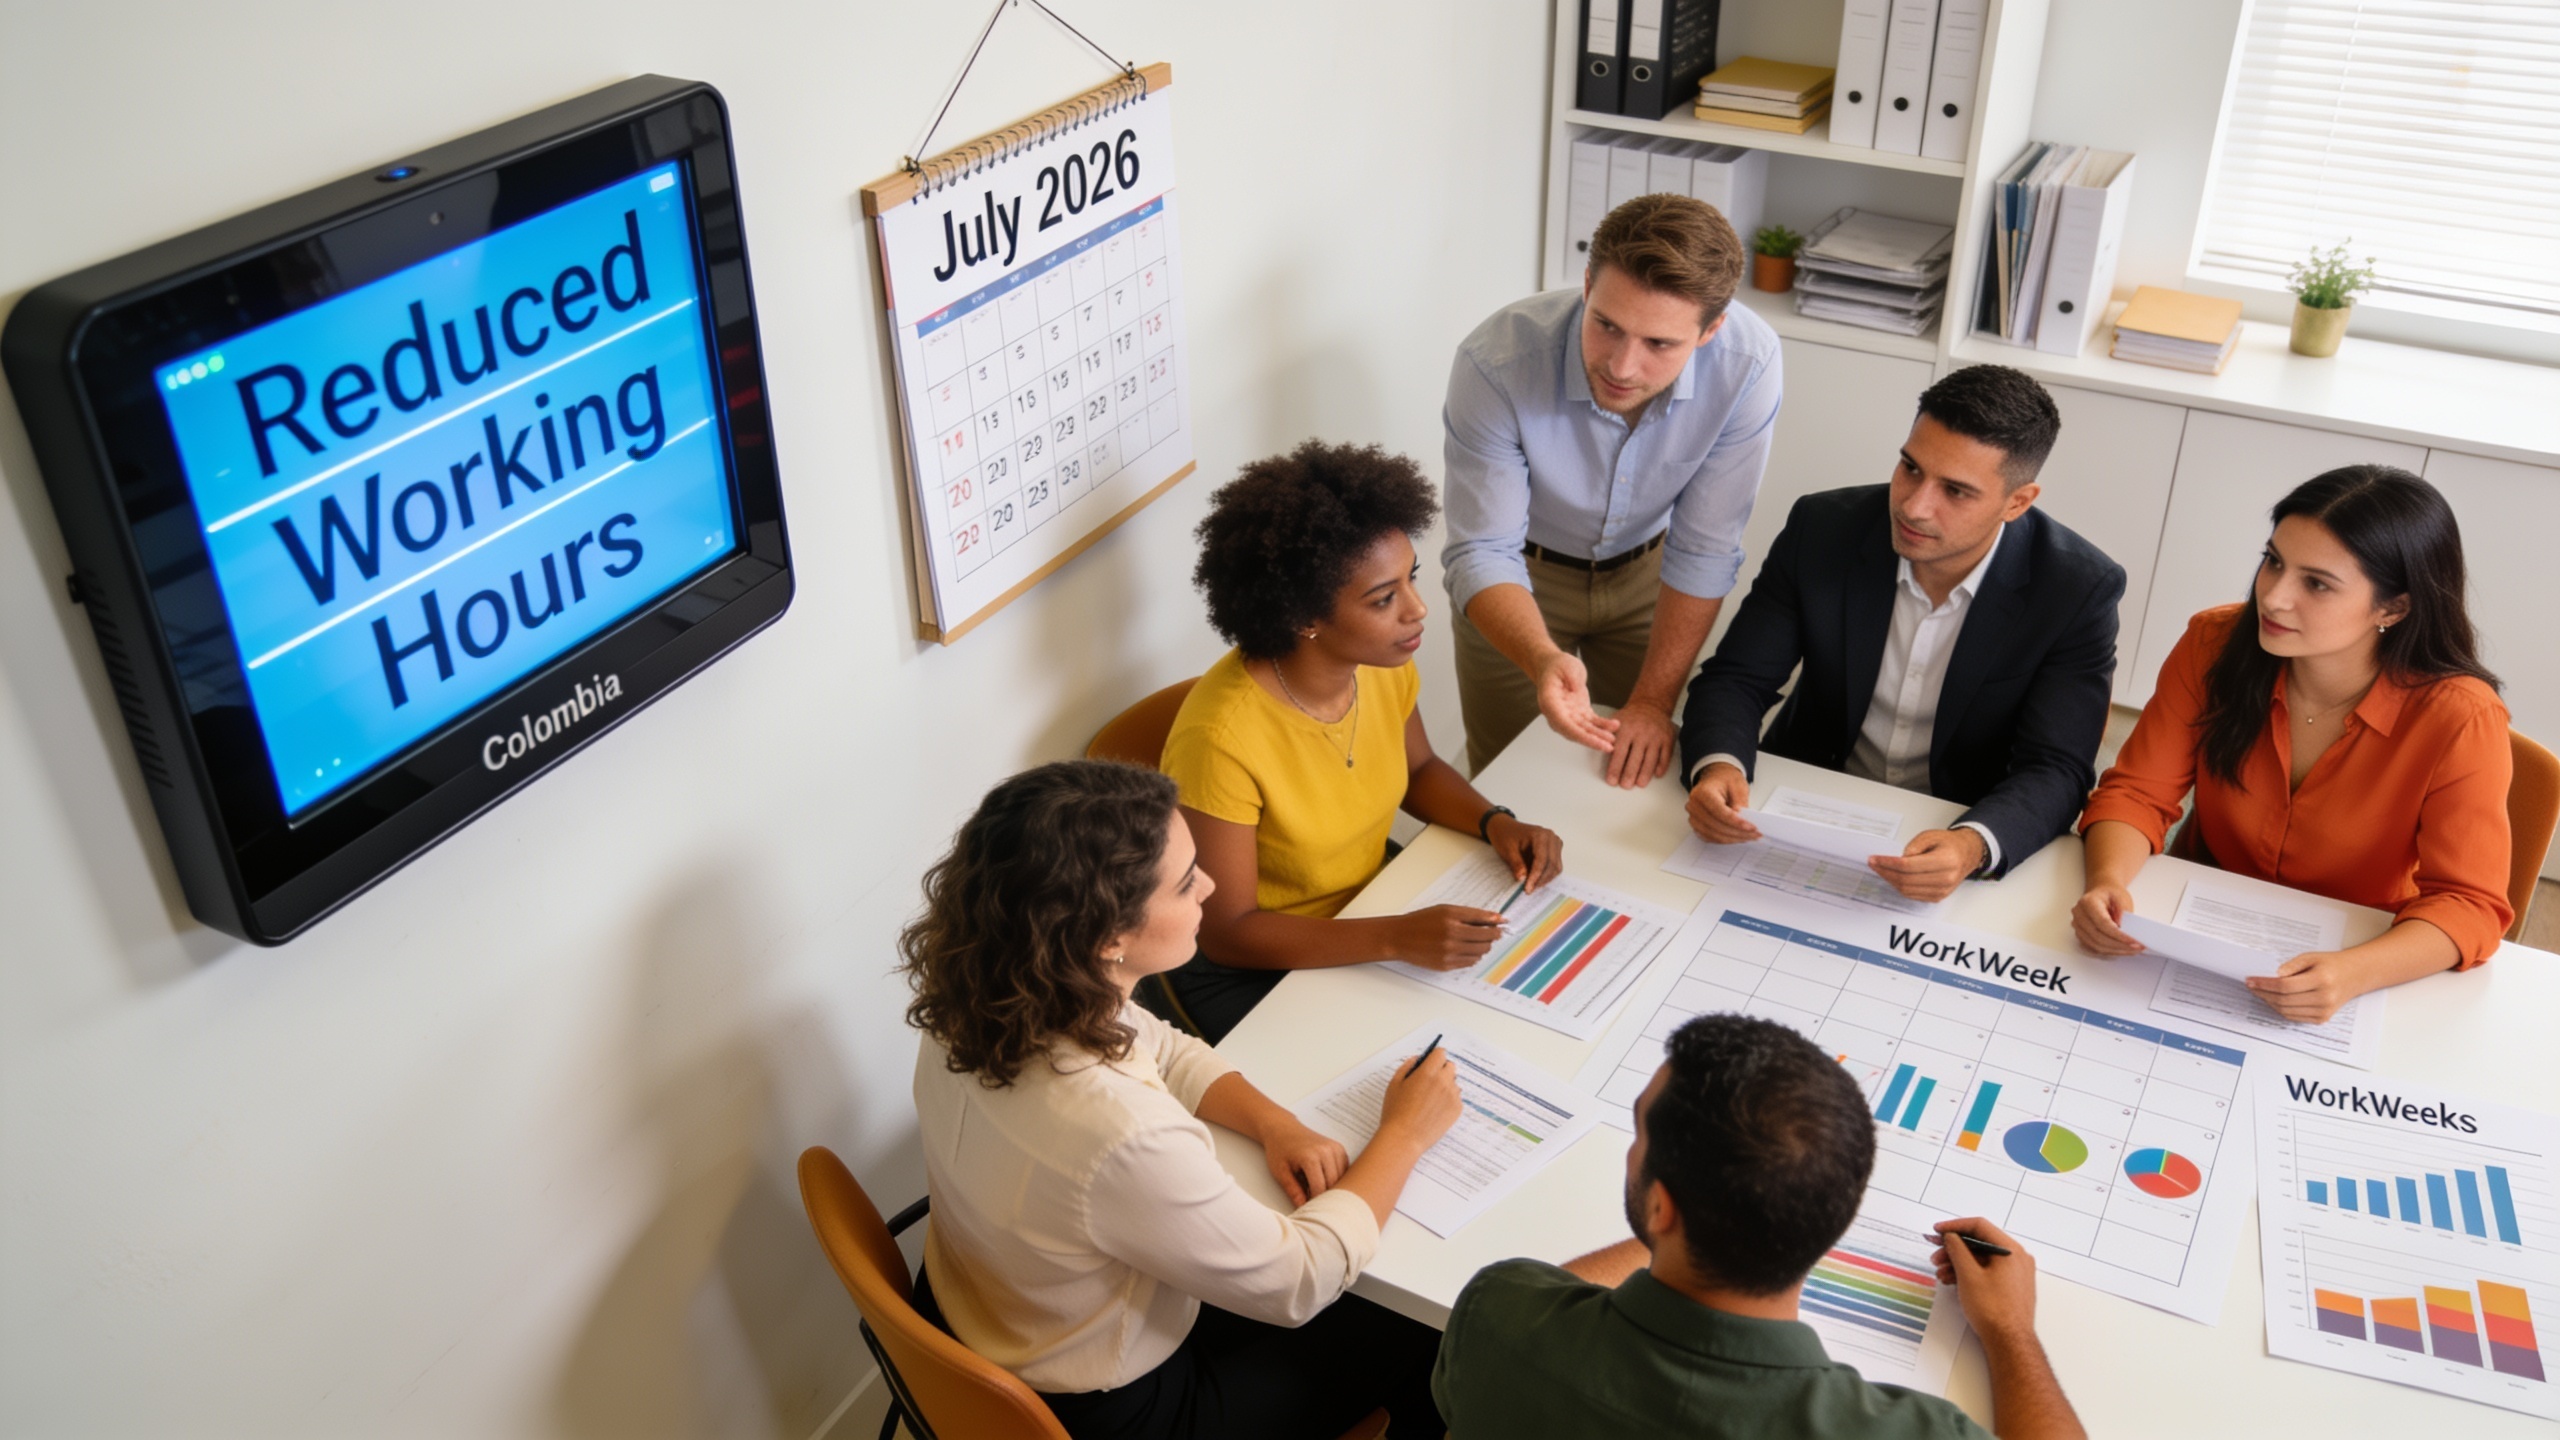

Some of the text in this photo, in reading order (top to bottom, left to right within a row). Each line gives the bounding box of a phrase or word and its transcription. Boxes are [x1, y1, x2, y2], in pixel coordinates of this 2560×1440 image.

[933, 129, 1140, 282] July 2026
[234, 209, 651, 478] Reduced
[272, 364, 666, 605] Working
[948, 478, 972, 508] 20
[993, 502, 1013, 532] 20
[371, 513, 643, 709] Hours
[483, 674, 623, 771] Colombia
[2285, 1074, 2479, 1134] WorkWeeks
